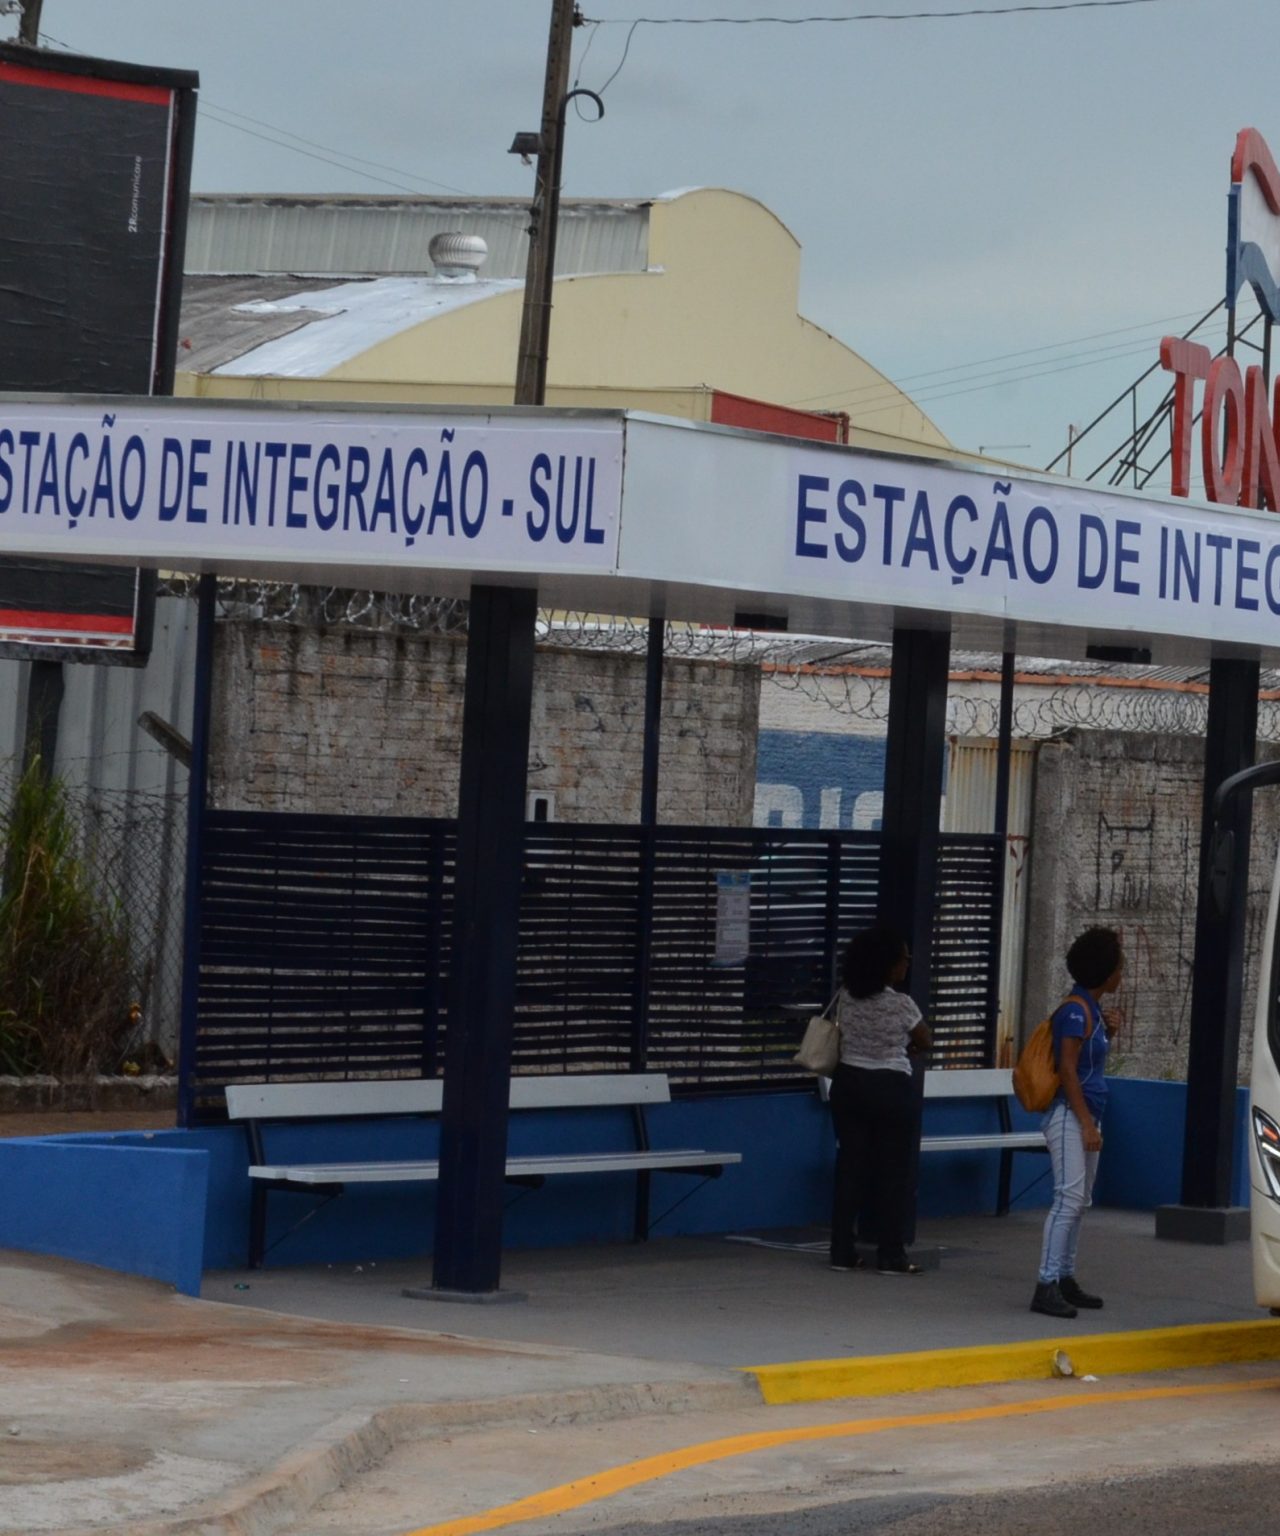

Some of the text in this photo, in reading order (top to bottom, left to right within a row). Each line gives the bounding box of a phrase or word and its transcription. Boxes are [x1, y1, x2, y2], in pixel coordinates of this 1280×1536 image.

[158, 438, 211, 523] DE
[222, 428, 488, 547] INTEGRAÇÃO
[502, 499, 514, 516] -
[526, 453, 605, 544] SUL
[795, 474, 1059, 585] ESTAÇÃO
[1077, 513, 1142, 596] DE
